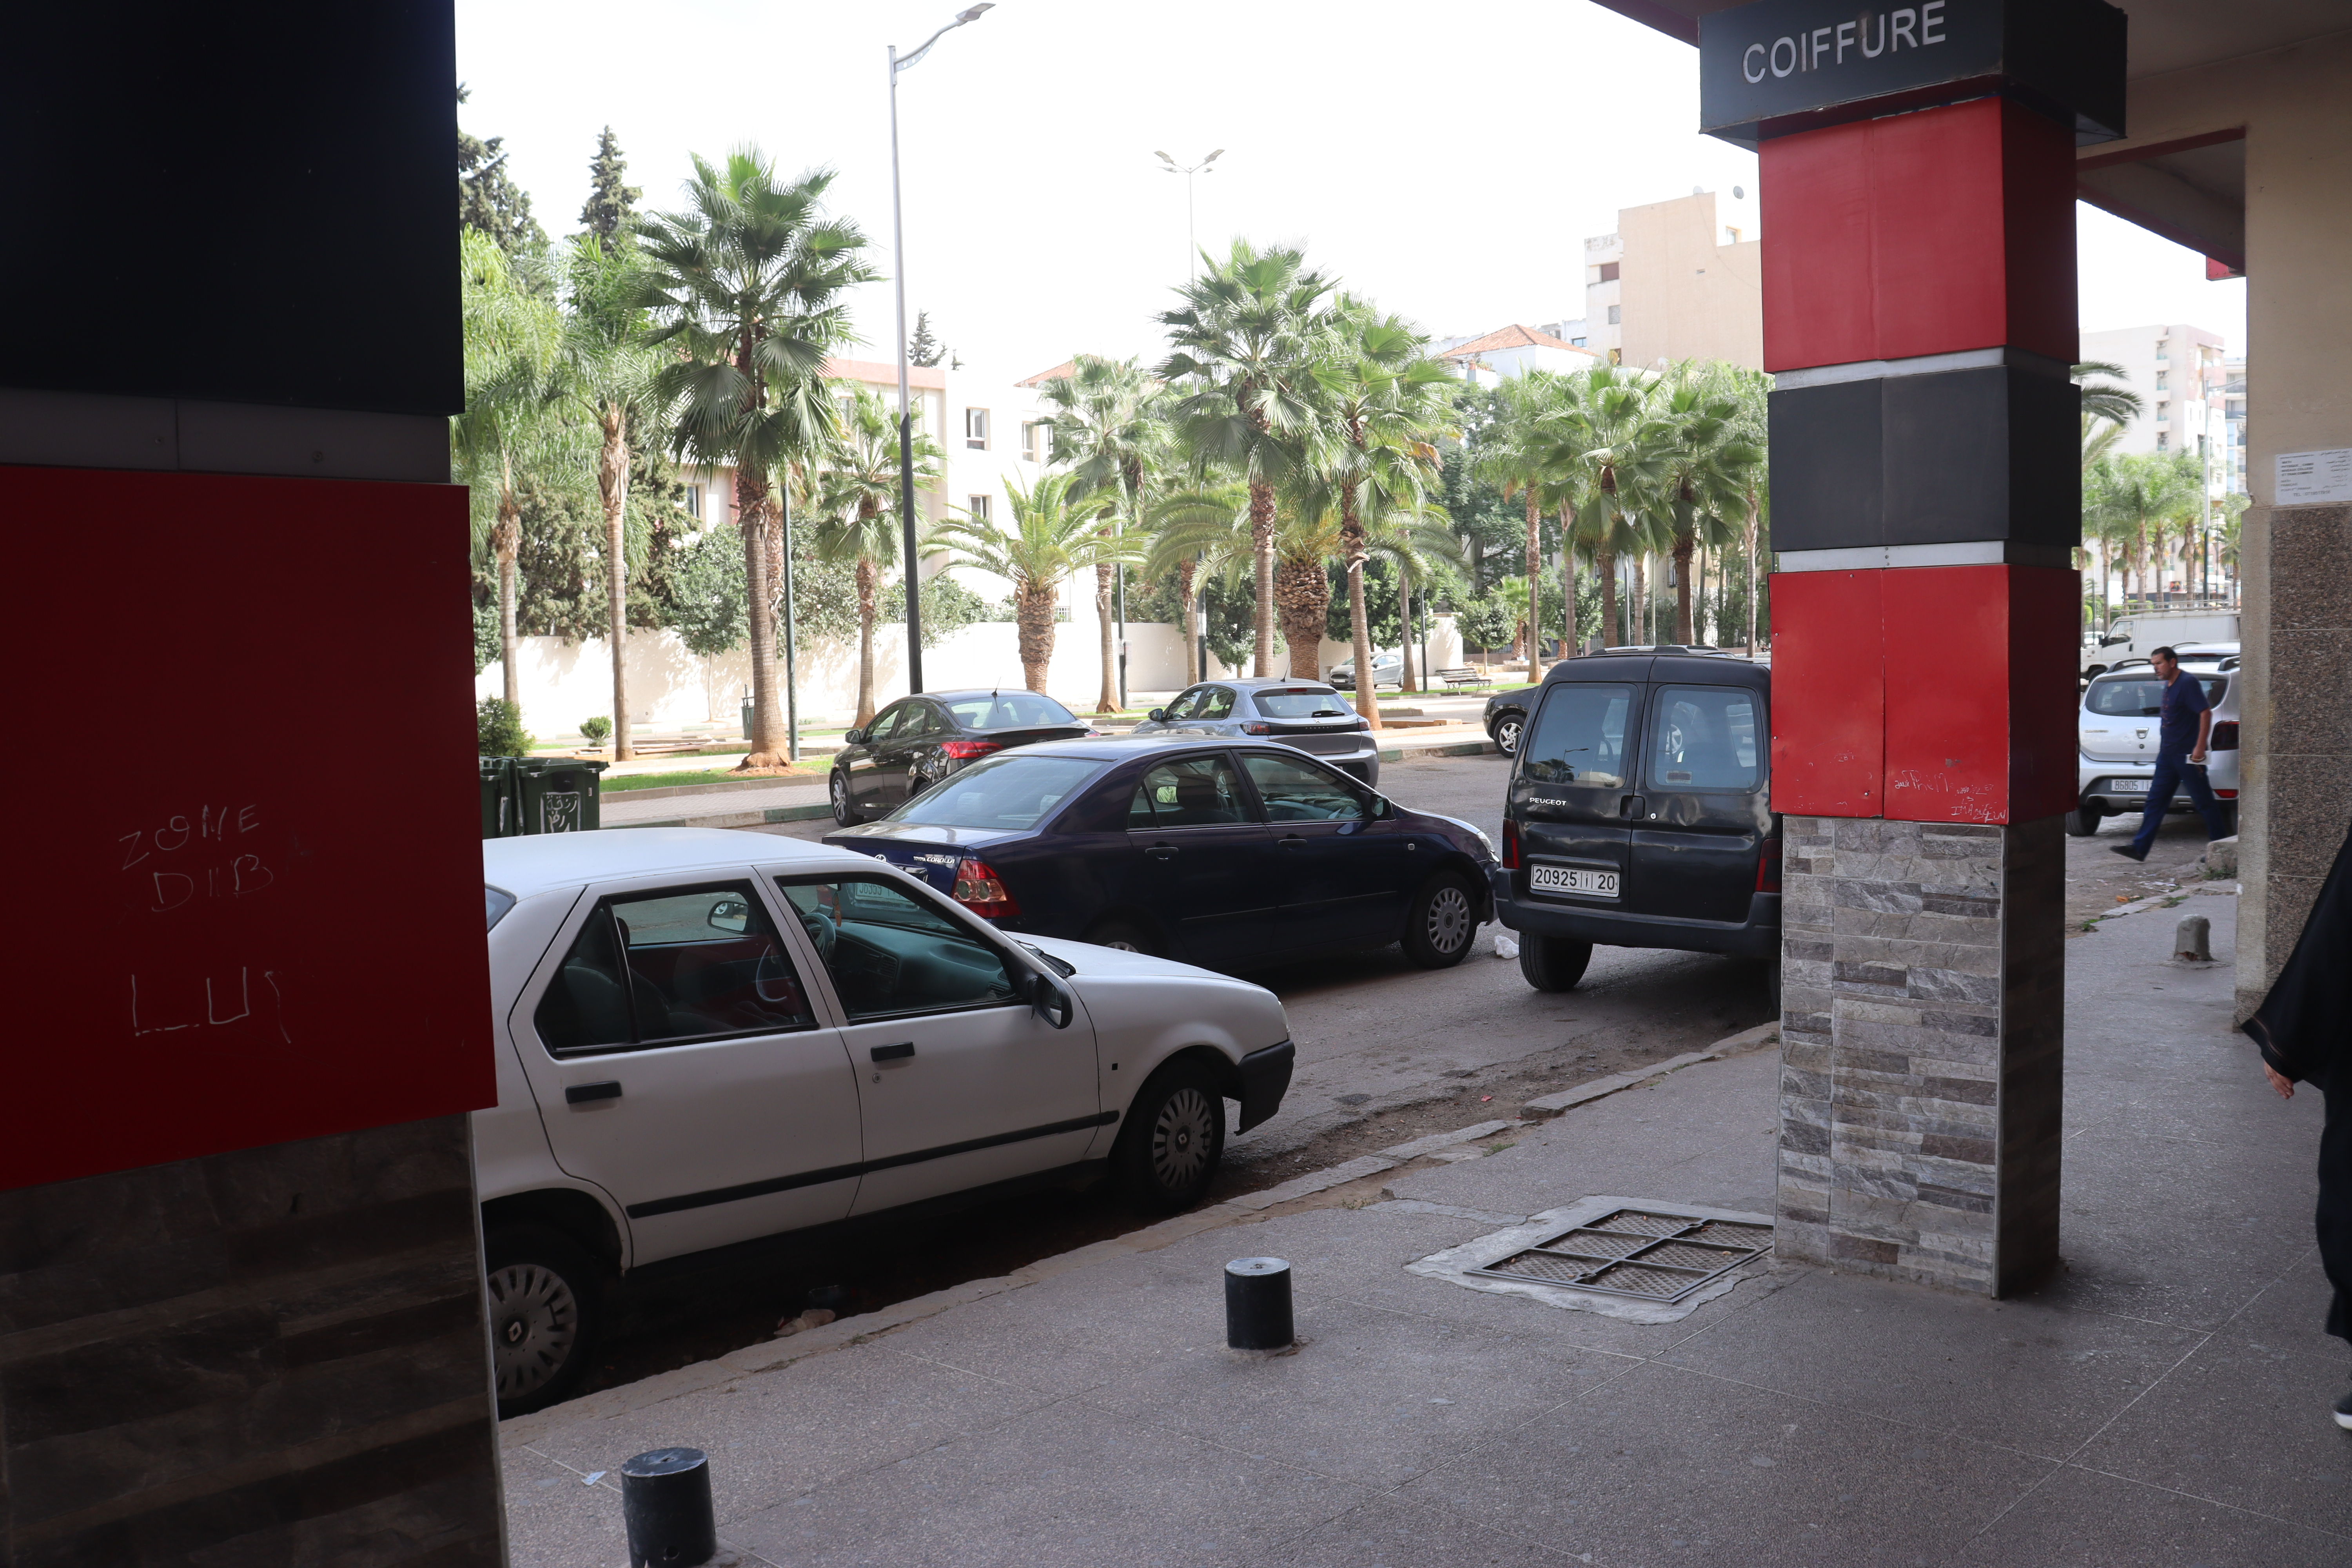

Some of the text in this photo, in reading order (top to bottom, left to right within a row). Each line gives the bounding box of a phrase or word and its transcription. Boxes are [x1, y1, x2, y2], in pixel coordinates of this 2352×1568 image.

[1742, 0, 1946, 84] COIFFURE
[1529, 797, 1566, 806] PEUGEOT
[119, 804, 260, 870] ZONE
[1535, 868, 1577, 887] 20925
[1598, 874, 1615, 890] 20
